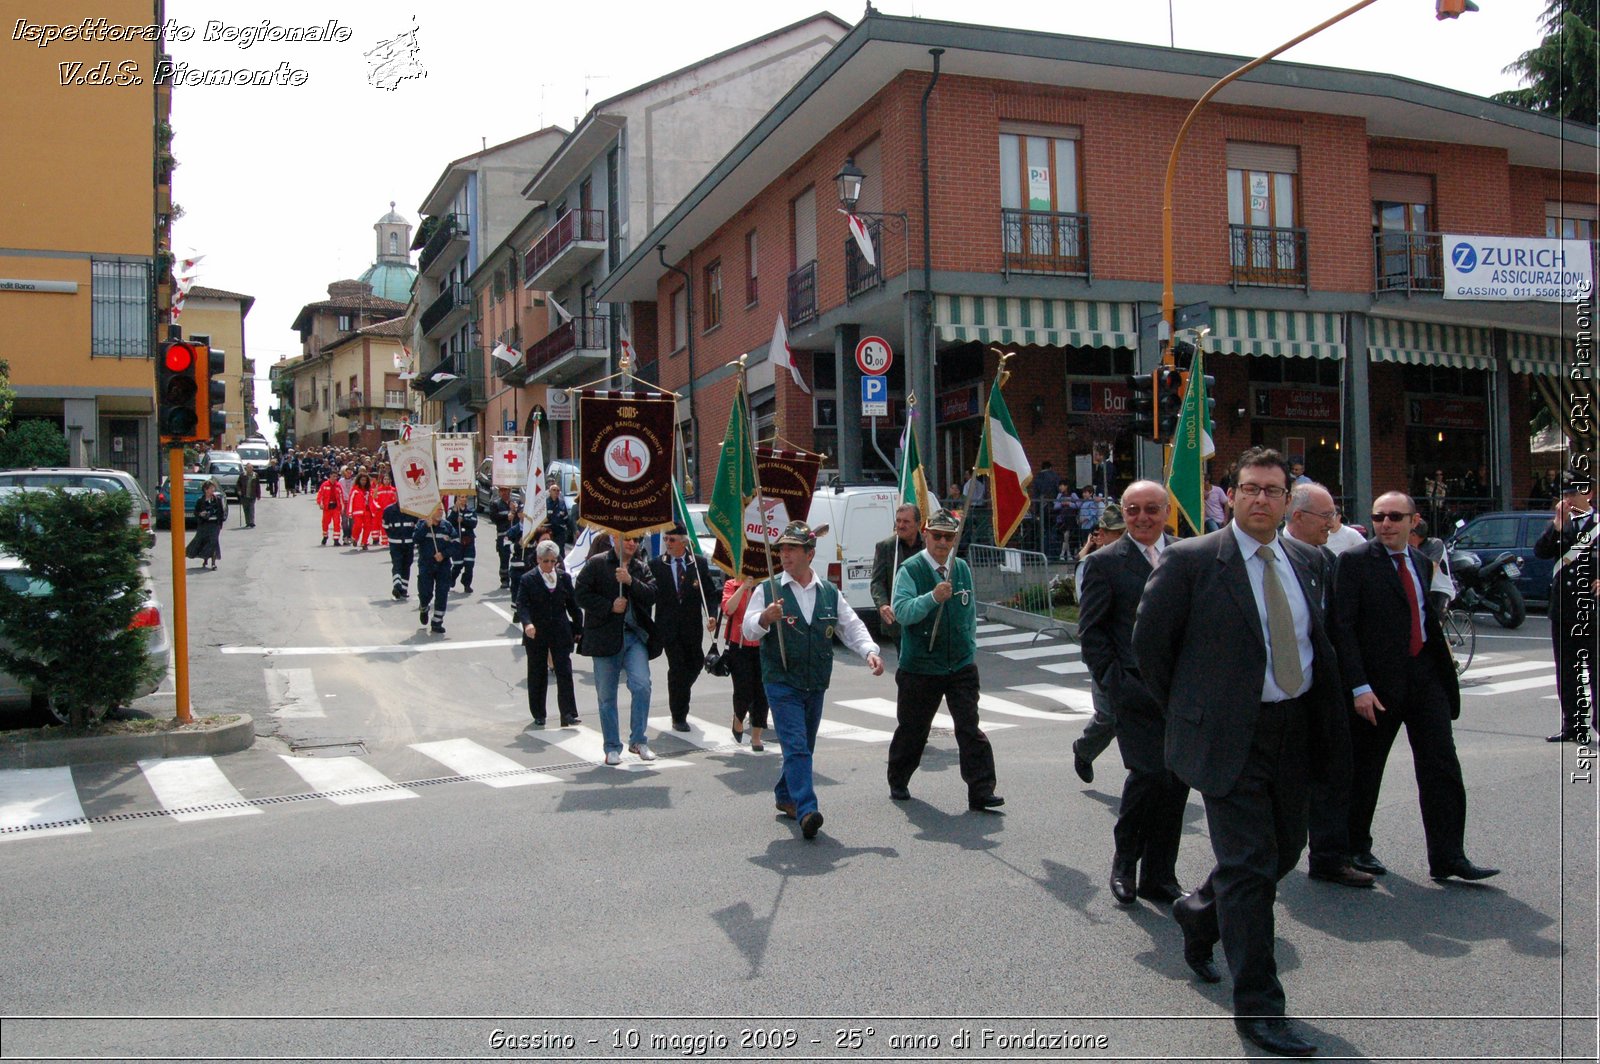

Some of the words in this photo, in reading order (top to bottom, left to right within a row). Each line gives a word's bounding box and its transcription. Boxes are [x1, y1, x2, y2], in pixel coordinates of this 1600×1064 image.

[1481, 247, 1566, 268] ZURICH
[1457, 286, 1508, 297] GASSINO
[867, 379, 882, 400] P
[1104, 388, 1127, 411] Bar
[1187, 402, 1195, 411] DI
[506, 421, 514, 431] P
[1186, 415, 1197, 449] TORINO
[591, 425, 613, 453] DONATORI
[615, 421, 640, 430] SANGUE
[643, 427, 663, 455] PIEMONTE
[726, 447, 736, 457] DI
[727, 461, 736, 496] TORINO
[583, 480, 610, 505] GRUPPO
[612, 500, 620, 508] DI
[622, 495, 656, 509] GASSINO
[746, 523, 779, 537] AIDAS
